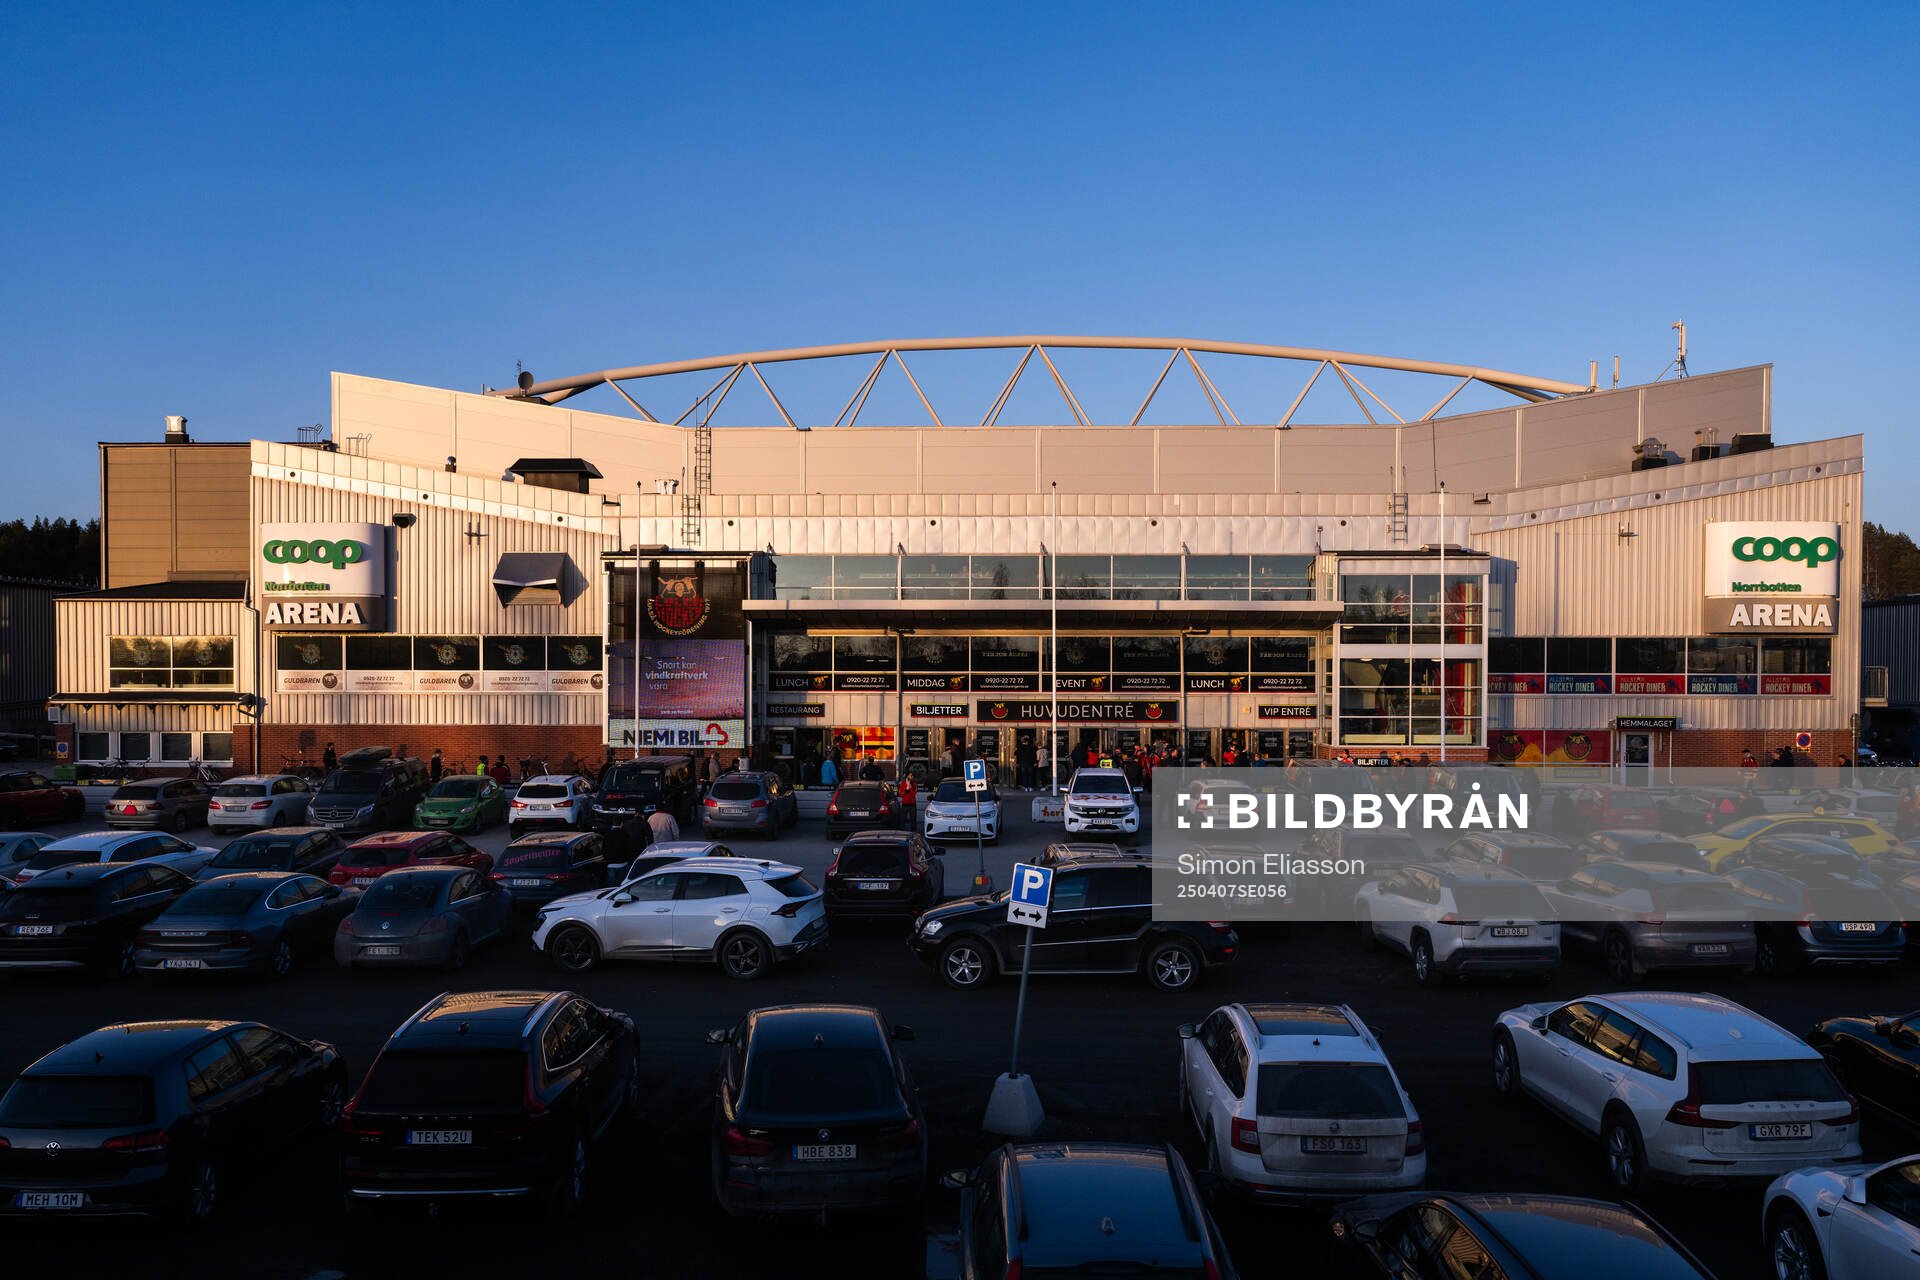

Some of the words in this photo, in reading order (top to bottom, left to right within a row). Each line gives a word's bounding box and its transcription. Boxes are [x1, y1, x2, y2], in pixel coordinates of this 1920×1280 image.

[263, 540, 362, 570] coop
[1732, 536, 1839, 568] coop
[1732, 581, 1802, 593] Norrbotten
[265, 602, 361, 625] ARENA
[1730, 603, 1833, 627] ARENA
[657, 660, 680, 670] Snart
[682, 660, 697, 669] kan
[645, 671, 709, 680] vindkraftverk
[775, 678, 809, 687] LUNCH
[907, 679, 945, 687] MIDDAG
[1056, 680, 1087, 688] EVENT
[1191, 680, 1225, 688] LUNCH
[1550, 682, 1573, 692] HOCKEY
[1575, 682, 1595, 692] DINER
[1620, 683, 1645, 693] HOCKEY
[1646, 683, 1666, 693] DINER
[1692, 683, 1717, 693] HOCKEY
[1718, 683, 1738, 693] DINER
[1766, 683, 1790, 693] HOCKEY
[1791, 683, 1812, 693] DINER
[770, 706, 820, 714] RESTAURANG
[916, 706, 962, 715] BILJETTER
[1021, 702, 1135, 718] HUVUDENTRÉ
[1263, 708, 1279, 716] VIP
[1281, 706, 1311, 716] ENTRÉ
[1620, 719, 1673, 728] HEMMALAGET
[623, 729, 674, 746] NIEMI
[679, 730, 704, 746] BIL
[1357, 758, 1389, 766] BILJETTER
[969, 762, 982, 779] P
[1021, 869, 1045, 900] P
[1844, 922, 1858, 930] USP
[1860, 922, 1873, 930] 490
[1760, 1126, 1781, 1137] GXR
[1785, 1124, 1806, 1136] 79F
[416, 1131, 440, 1143] TEK
[444, 1131, 467, 1143] 52U
[802, 1147, 825, 1158] HBE
[829, 1146, 851, 1157] 838
[26, 1194, 50, 1206] MEH
[55, 1194, 78, 1206] 10M
